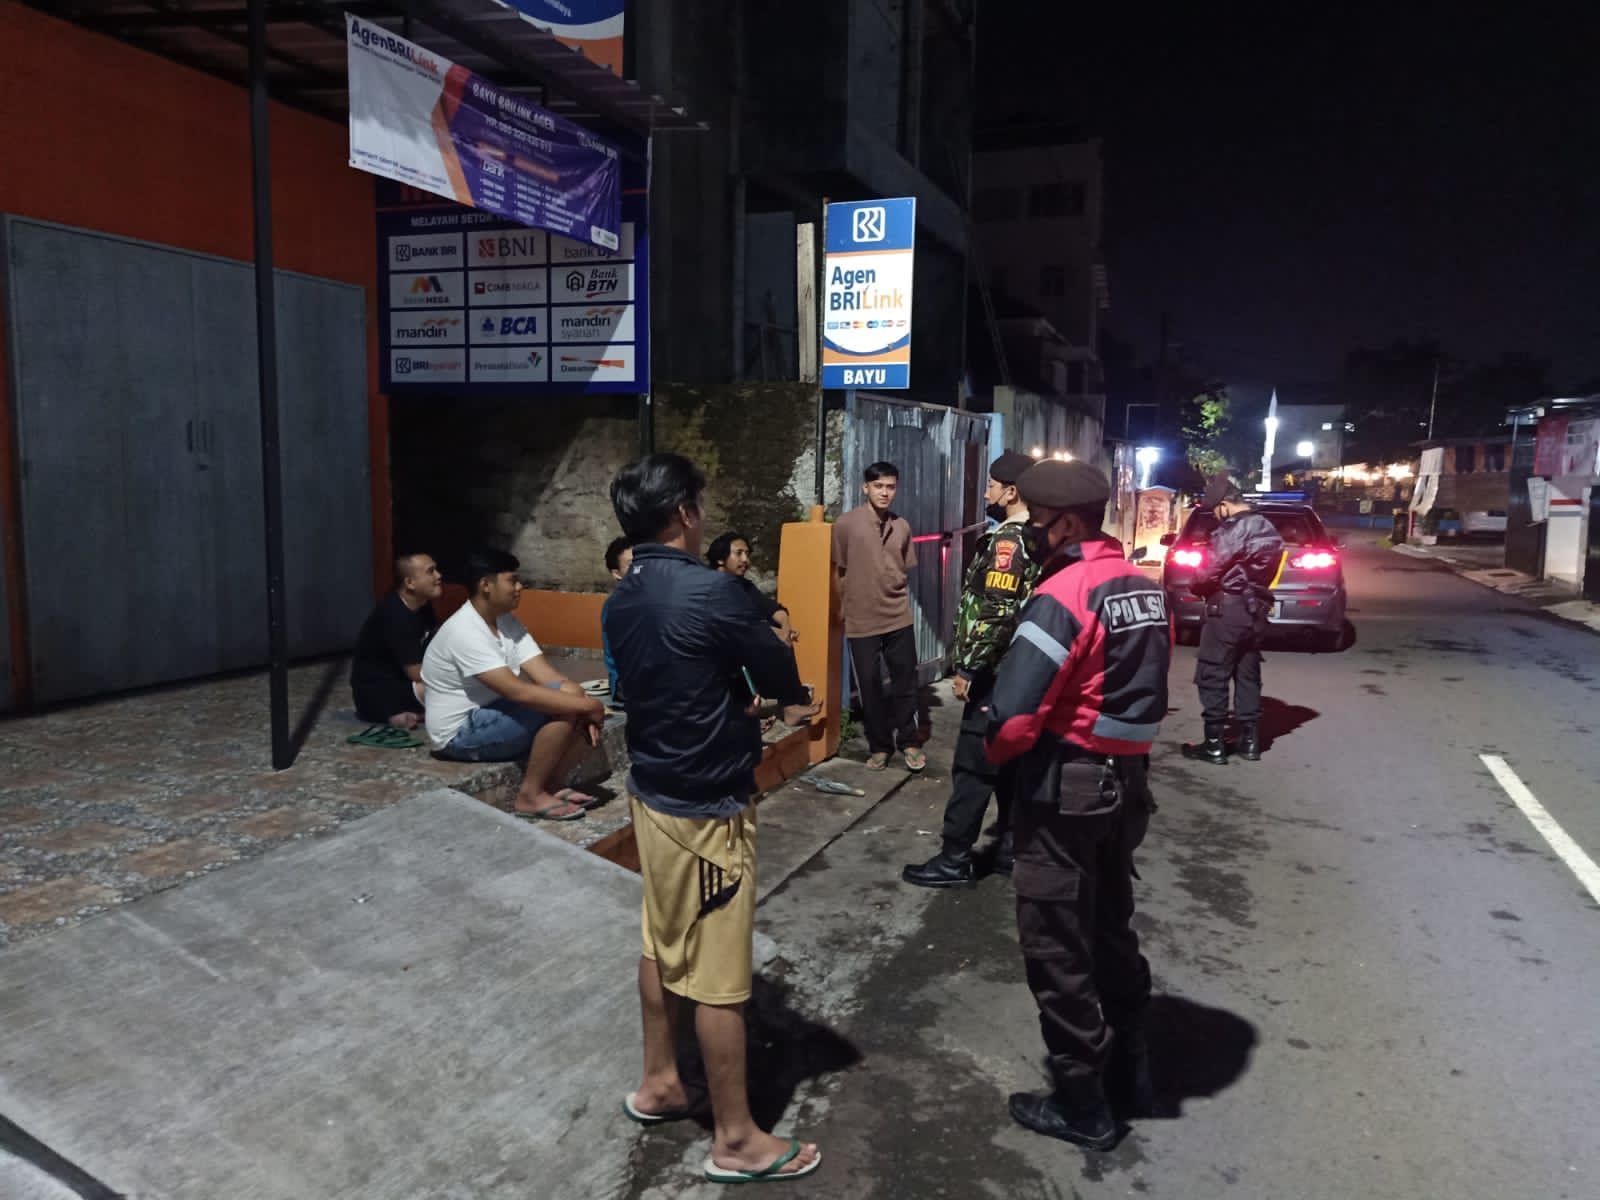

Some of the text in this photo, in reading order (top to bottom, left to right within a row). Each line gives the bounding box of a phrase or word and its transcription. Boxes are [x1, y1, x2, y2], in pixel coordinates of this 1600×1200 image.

[351, 19, 438, 75] AgenBRILink
[409, 214, 458, 227] MELAYANI
[412, 246, 457, 257] BANK BRI
[498, 236, 535, 257] BNI
[590, 268, 618, 279] Bank
[831, 266, 876, 289] Agen
[586, 279, 618, 292] BTN
[830, 287, 904, 311] BRILink
[500, 316, 537, 336] BCA
[561, 315, 610, 327] mandiri
[396, 326, 447, 338] mandiri
[843, 369, 886, 385] BAYU
